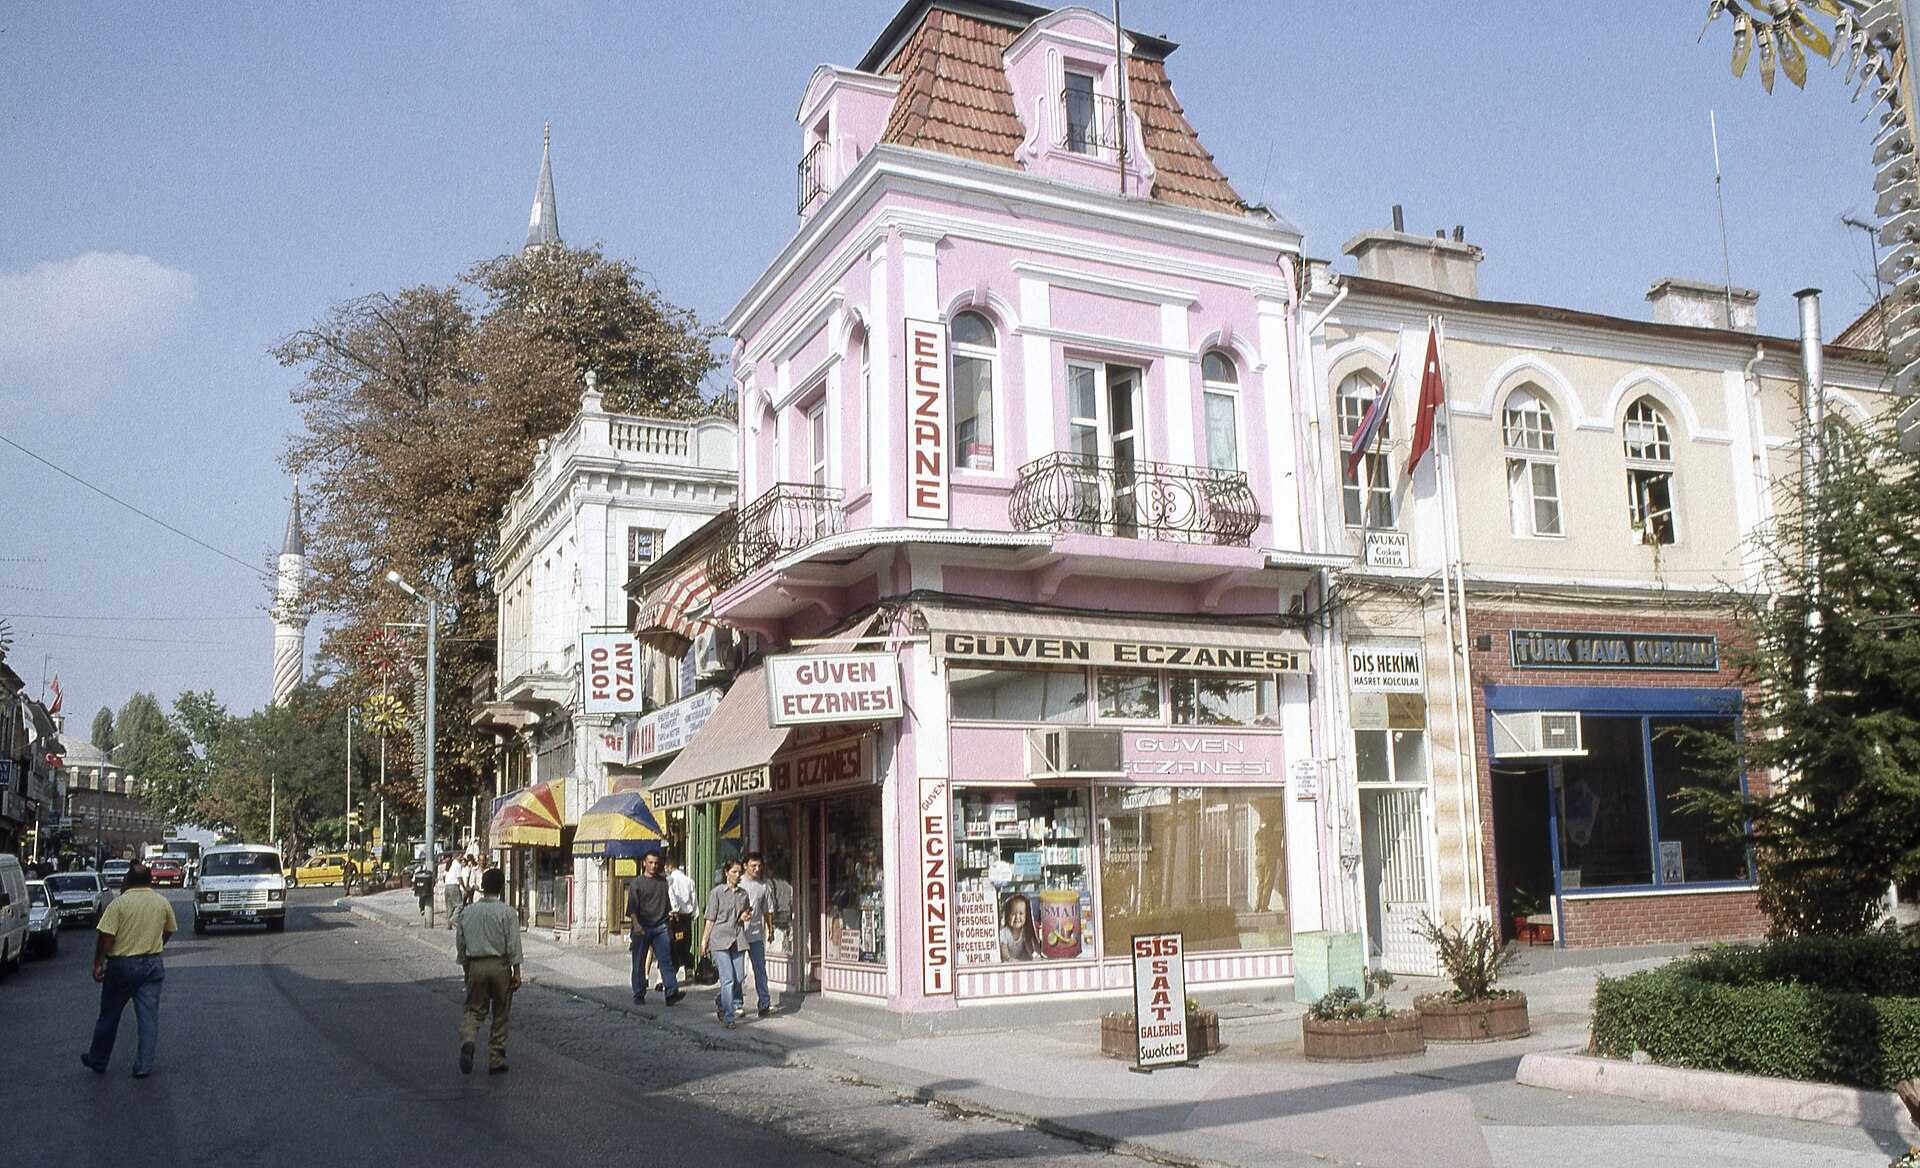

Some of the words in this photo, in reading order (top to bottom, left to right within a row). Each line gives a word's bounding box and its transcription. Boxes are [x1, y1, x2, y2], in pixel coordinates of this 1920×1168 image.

[914, 330, 941, 509] ECZANE
[1368, 534, 1406, 546] AVUKAT
[944, 633, 1089, 660] GÜVEN
[1113, 643, 1299, 671] ECZANESİ
[1353, 651, 1375, 675] DİŞ
[1376, 651, 1419, 673] HEKİMİ
[1517, 632, 1572, 663] TÜRK
[1577, 640, 1630, 663] HAVA
[1634, 641, 1716, 665] KURUMU
[591, 647, 610, 700] FOTO
[615, 643, 634, 702] OZAN
[796, 661, 876, 685] GÜVEN
[1354, 676, 1380, 685] HASRET
[1383, 677, 1419, 686] KOLCULAR
[782, 685, 894, 716] ECZANESİ
[1135, 738, 1244, 753] GÜVEN
[653, 787, 689, 809] GÜVEN
[695, 768, 765, 799] ECZANESİ
[925, 816, 947, 989] ECZANESİ
[1136, 935, 1178, 958] SİS
[1151, 960, 1171, 1020] SAAT
[1141, 1021, 1182, 1039] GALERİSİ
[1141, 1042, 1176, 1060] Swatch
